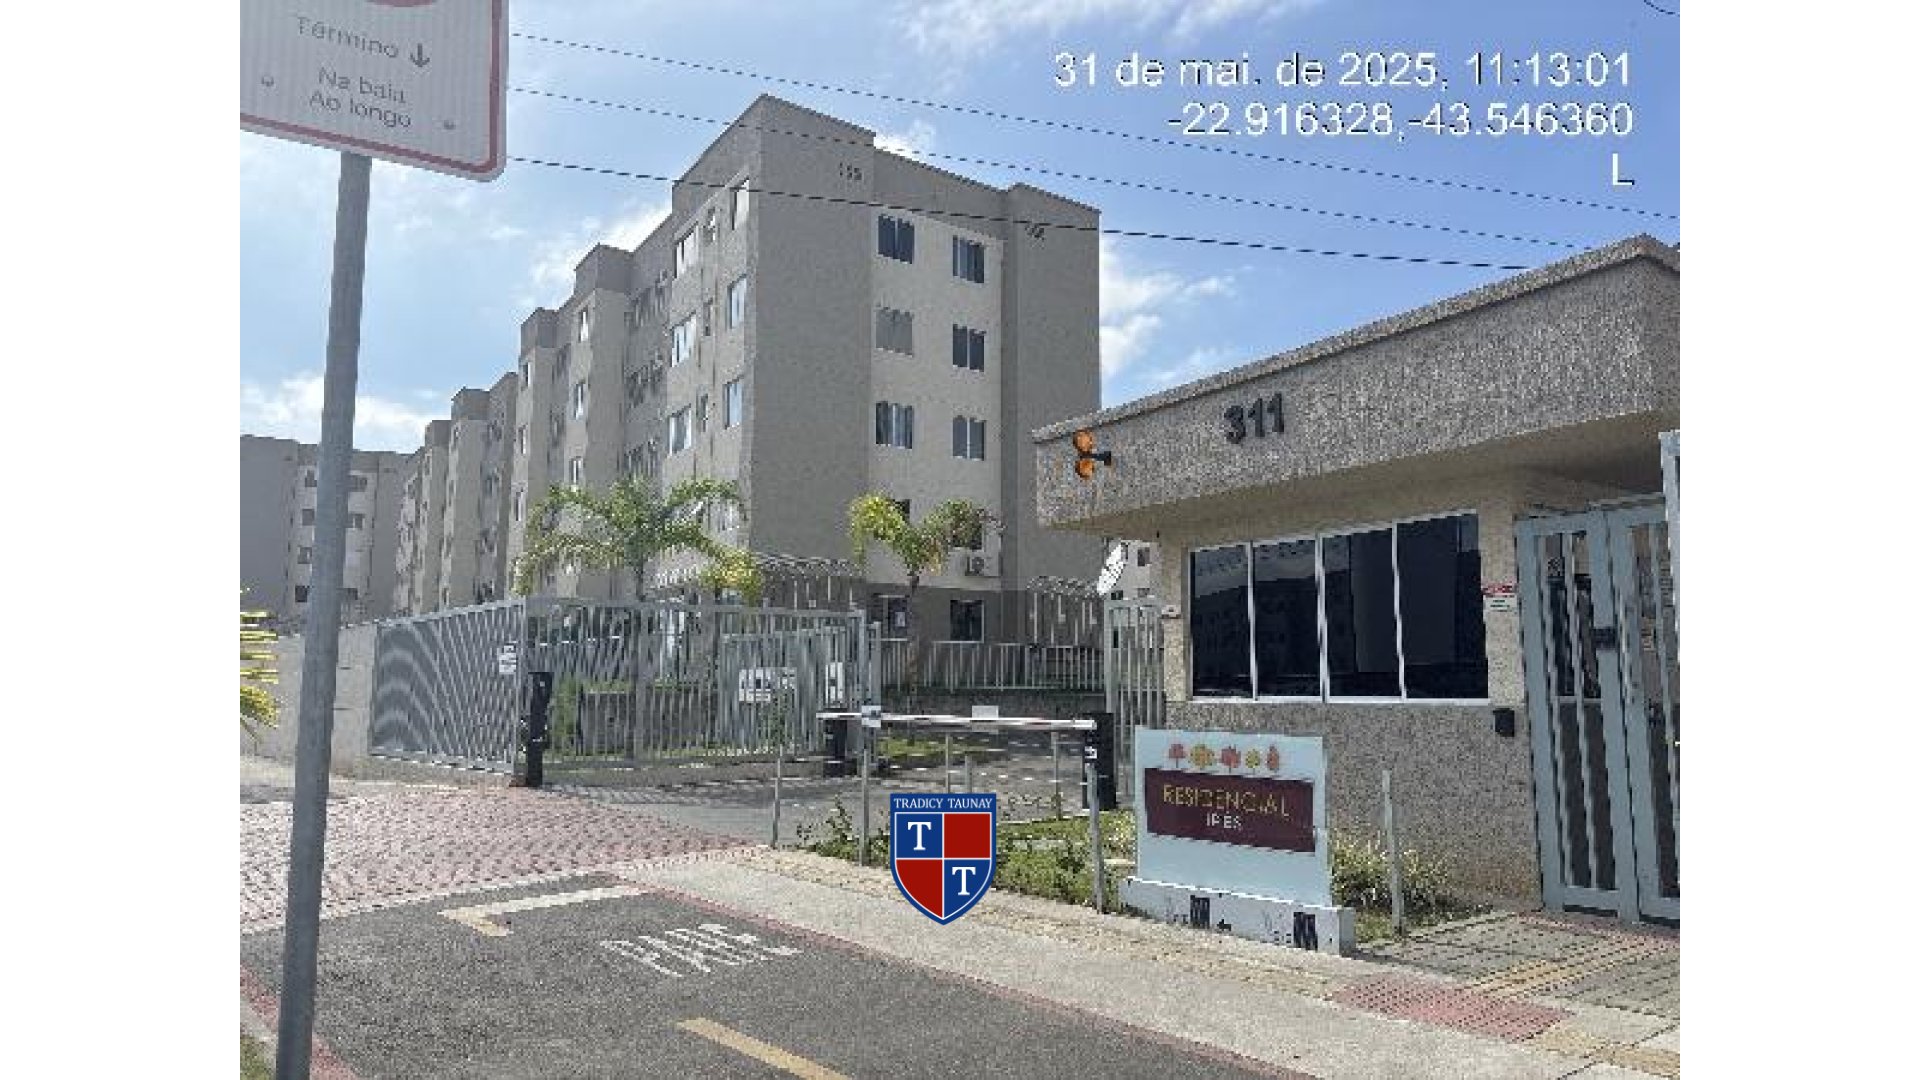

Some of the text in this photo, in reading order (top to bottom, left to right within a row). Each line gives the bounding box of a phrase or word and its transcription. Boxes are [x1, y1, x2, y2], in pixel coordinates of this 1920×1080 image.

[318, 66, 351, 90] Na
[309, 90, 412, 128] Ao longo
[1224, 393, 1285, 444] 311
[1163, 784, 1290, 818] RESIDENCIAL
